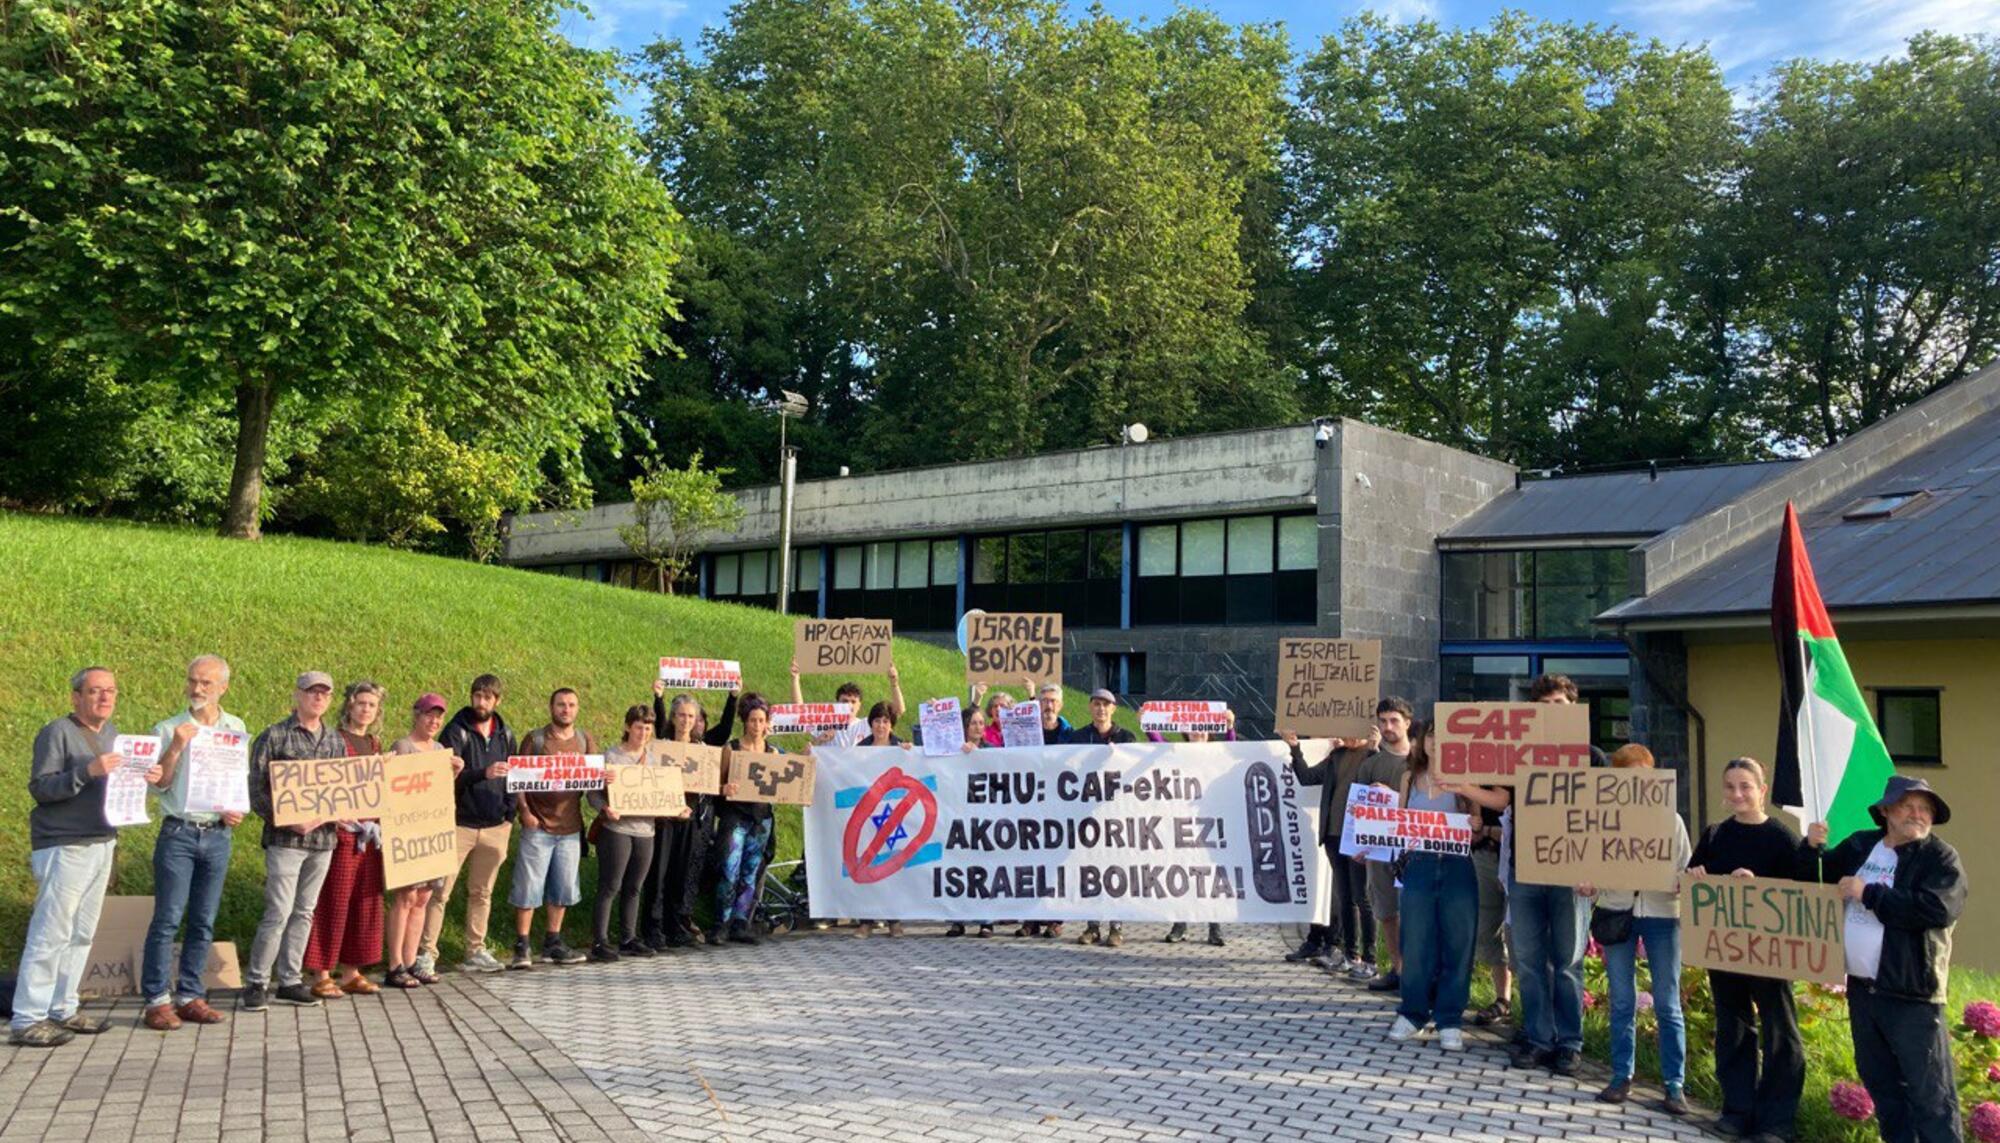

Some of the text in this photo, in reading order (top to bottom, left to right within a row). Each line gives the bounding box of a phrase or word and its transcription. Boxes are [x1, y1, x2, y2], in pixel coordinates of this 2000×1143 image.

[804, 623, 891, 642] HP/CAF/AXA
[974, 615, 1061, 645] ISRAEL
[968, 643, 1060, 676] BOIKOT
[1285, 642, 1361, 660] ISRAEL
[661, 657, 725, 670] PALESTINA
[663, 678, 696, 688] SRAELI
[1285, 682, 1324, 699] CAF
[768, 703, 834, 714] PALESTINA
[934, 701, 955, 713] CAF
[1014, 706, 1034, 717] CAF
[1143, 702, 1210, 712] PALESTINA
[772, 723, 848, 732] SRAELI BOIKOT
[1191, 723, 1226, 731] BOIKOT
[1447, 708, 1536, 740] CAF
[133, 741, 157, 756] CAF
[1441, 742, 1590, 775] BOIKOT
[509, 755, 586, 769] PALESTINA
[270, 758, 385, 792] PALESTINA
[391, 770, 434, 795] CAF
[509, 779, 603, 791] ISRAELI BOIKOT
[620, 765, 665, 789] CAF
[967, 768, 1203, 804] EHU: CAF-ekin
[1524, 772, 1586, 806] CAF
[277, 781, 381, 816] ASKATU
[1367, 790, 1393, 805] CAF
[1354, 804, 1448, 826] PALESTINA
[1566, 809, 1621, 833] EHU
[945, 815, 1228, 851] AKORDIORIK EZ!
[1281, 763, 1308, 905] labur.eus/bdz
[1396, 823, 1471, 843] ASKATU!
[391, 831, 456, 864] BOIKOT
[1355, 834, 1470, 855] ISRAELI BOIKOT
[1601, 837, 1673, 864] KARGU
[933, 864, 1246, 900] ISRAELI BOIKOTA!
[1704, 929, 1828, 974] ASKATU
[87, 961, 129, 982] AXA
